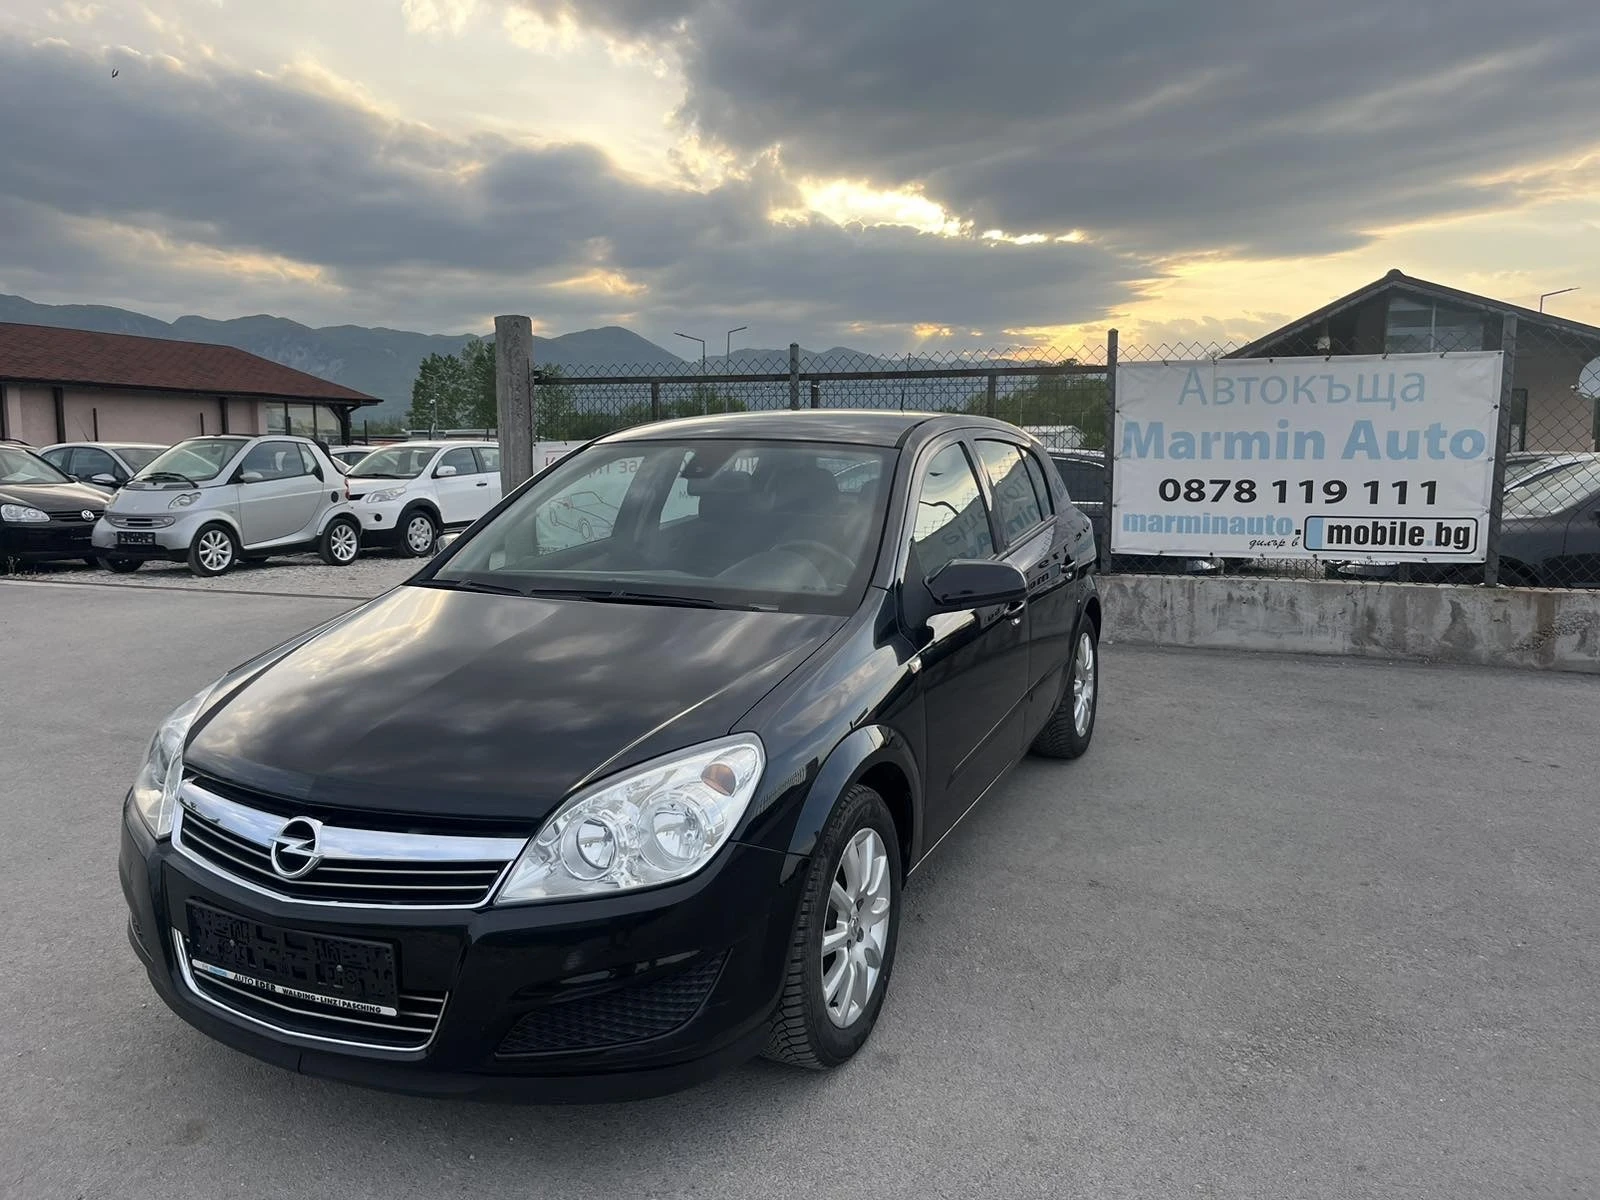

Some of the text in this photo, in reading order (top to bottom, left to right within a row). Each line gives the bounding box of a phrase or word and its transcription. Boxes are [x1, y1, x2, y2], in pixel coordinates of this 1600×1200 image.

[1178, 366, 1425, 411] Автокъща
[1122, 419, 1486, 460] Marmin Auto
[1158, 478, 1437, 505] 0878 119 111
[234, 974, 254, 985] AUTO
[256, 980, 277, 991] EDER
